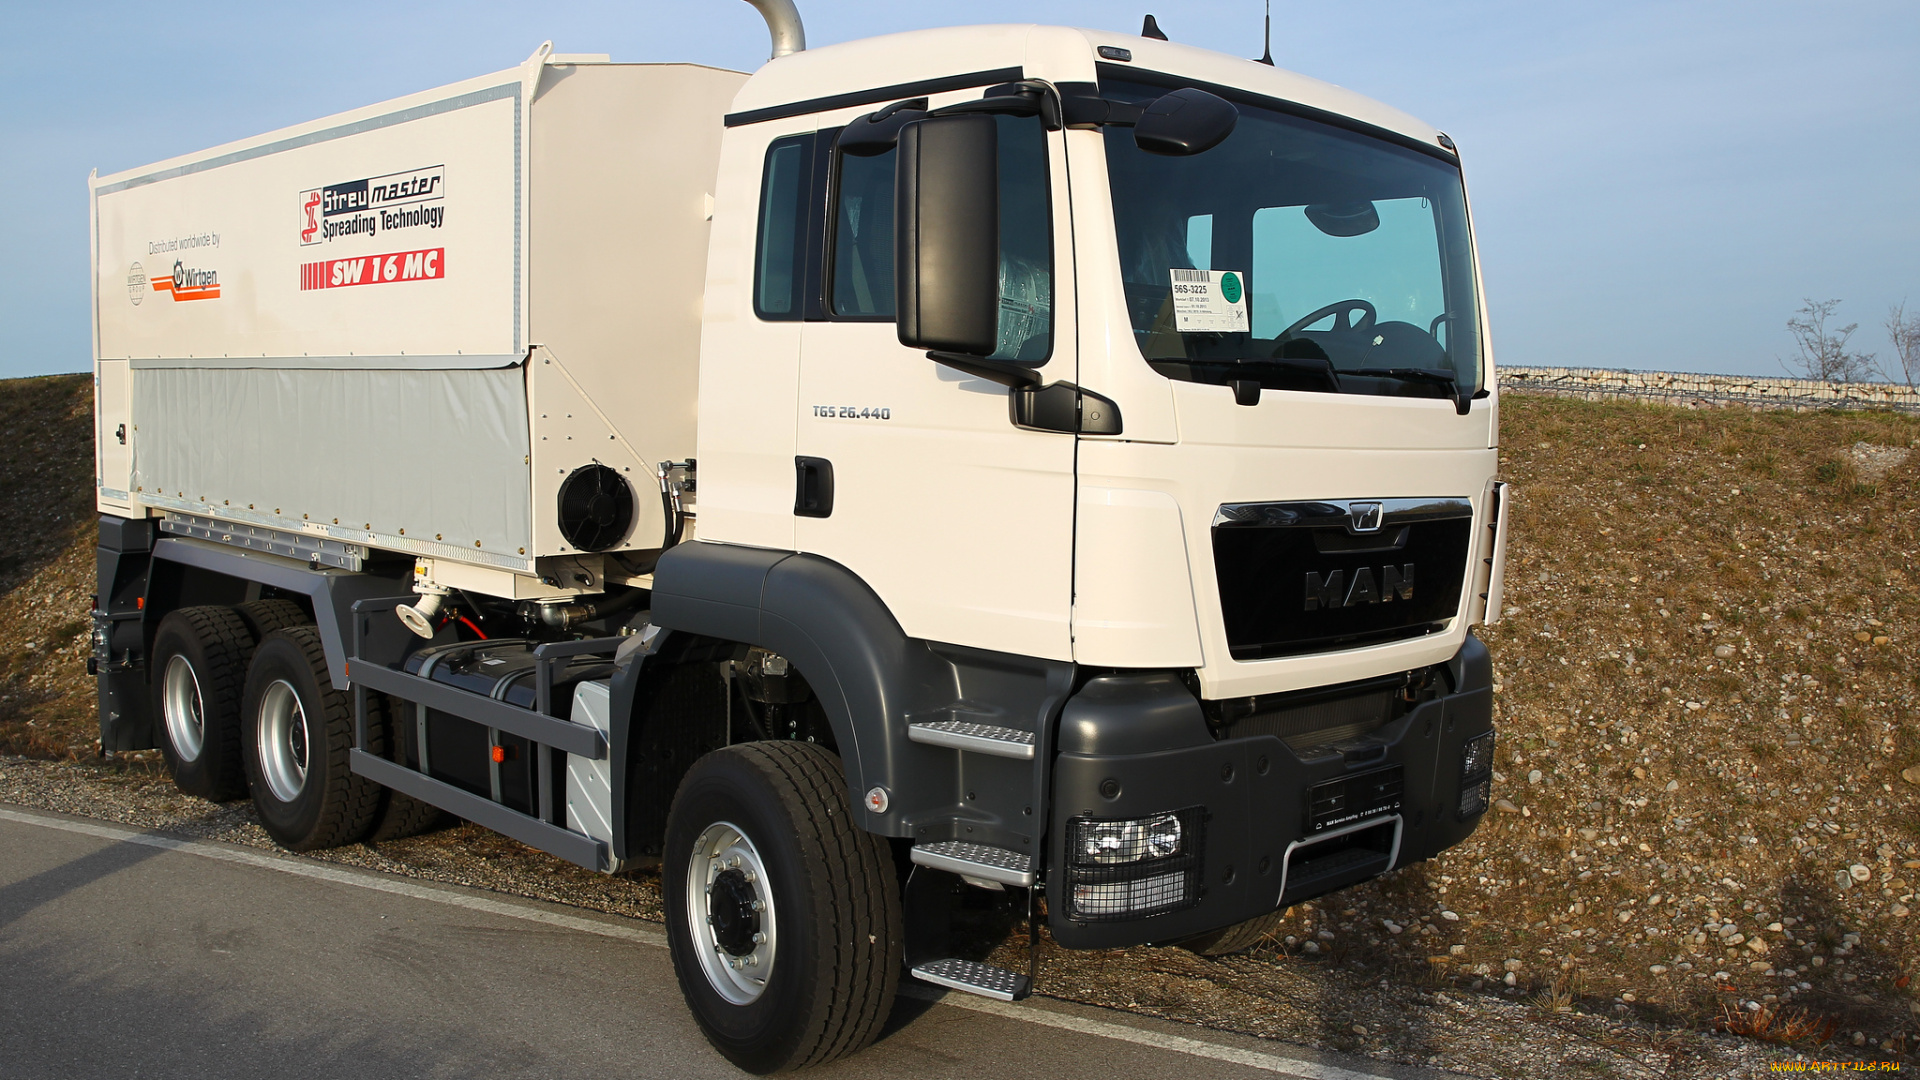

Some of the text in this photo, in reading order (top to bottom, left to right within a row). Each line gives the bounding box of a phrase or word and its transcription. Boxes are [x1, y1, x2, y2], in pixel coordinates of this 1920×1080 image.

[323, 175, 441, 212] Streu master
[323, 204, 444, 242] Spreading Technology
[149, 230, 221, 255] Distributed worldwide by
[185, 268, 217, 290] Wirtgen
[331, 250, 438, 286] SW 16 MC
[1174, 284, 1207, 294] 56S-3225
[813, 405, 890, 420] TGS 26.440
[1304, 563, 1414, 611] MAN
